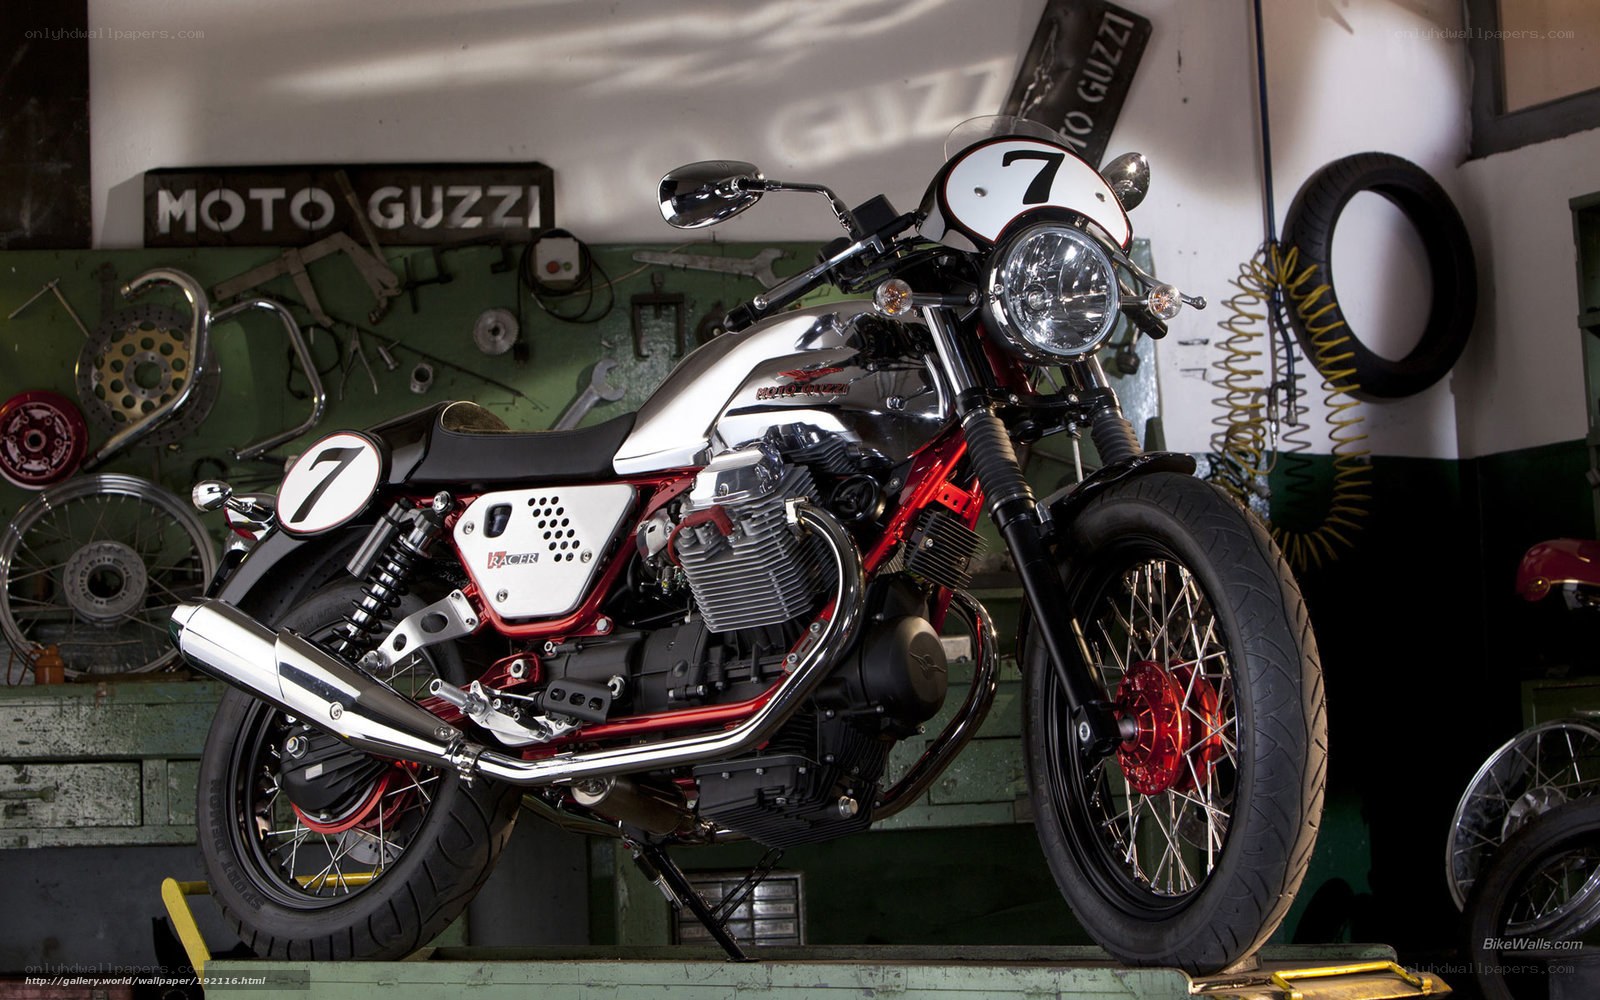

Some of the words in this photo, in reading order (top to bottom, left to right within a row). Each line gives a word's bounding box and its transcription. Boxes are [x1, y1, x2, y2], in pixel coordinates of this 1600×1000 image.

[1053, 111, 1093, 149] TO
[1077, 11, 1135, 103] GUZZI
[1002, 150, 1066, 205] 7
[157, 187, 336, 233] MOTO
[368, 185, 541, 230] GUZZI
[756, 384, 797, 400] MOTO
[801, 383, 850, 397] GUZZI
[289, 446, 366, 523] 7
[490, 553, 539, 567] RACER
[208, 779, 227, 854] DEMON
[221, 862, 264, 911] SPORT
